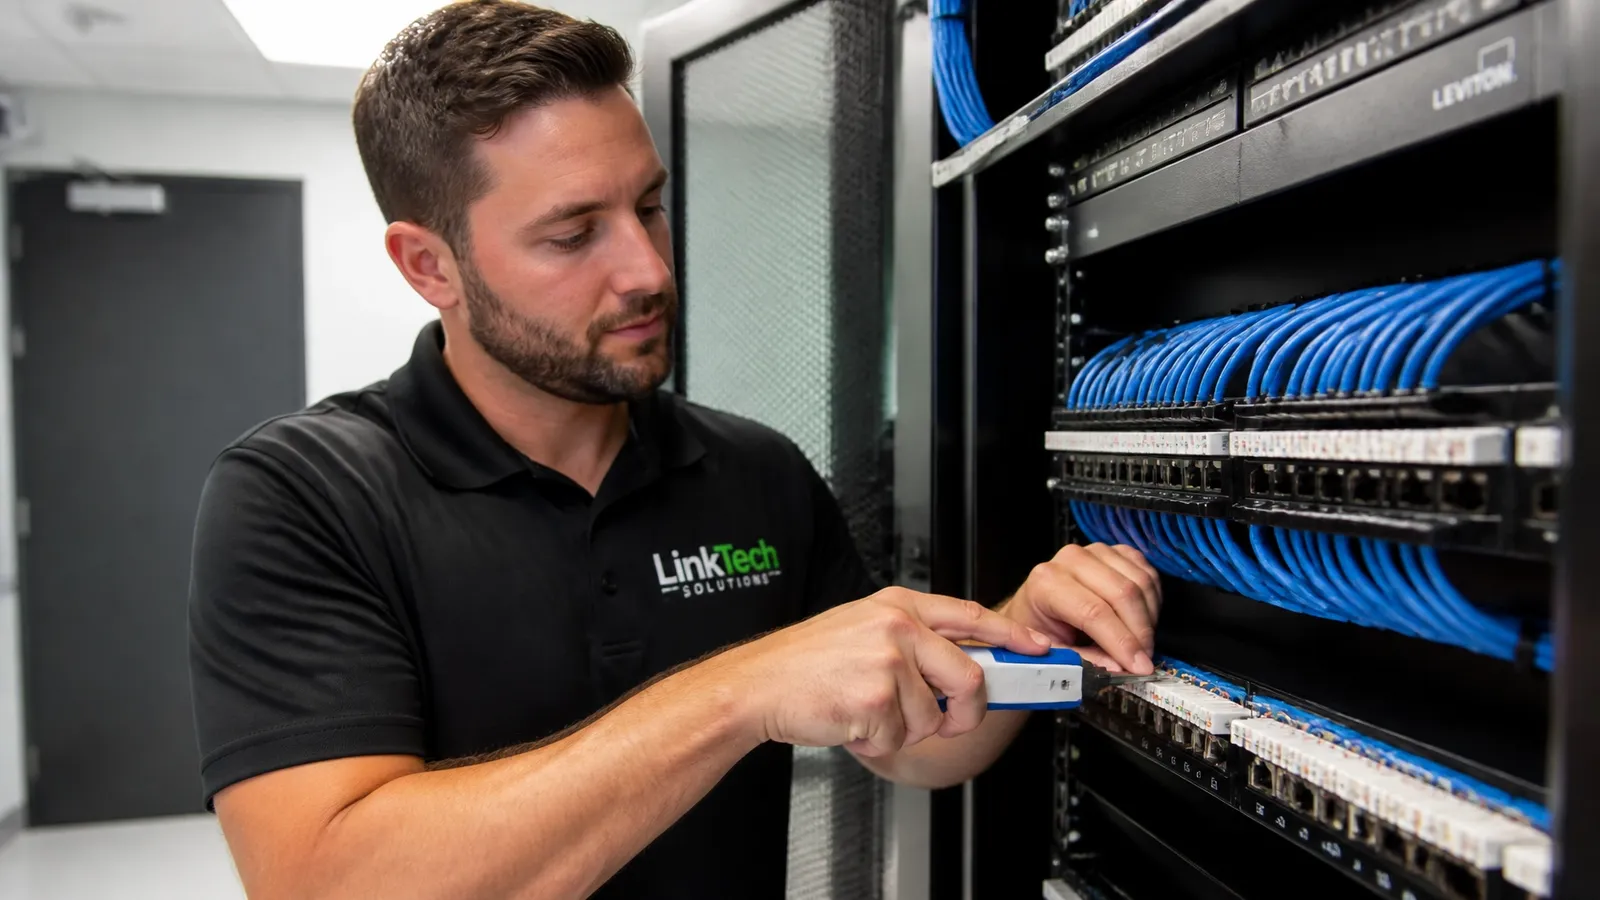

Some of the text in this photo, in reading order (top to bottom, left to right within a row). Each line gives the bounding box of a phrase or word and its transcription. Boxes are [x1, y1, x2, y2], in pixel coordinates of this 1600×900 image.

[1432, 61, 1515, 110] LEVITON
[652, 538, 779, 585] LinkTech
[682, 573, 770, 598] SOLUTIONS
